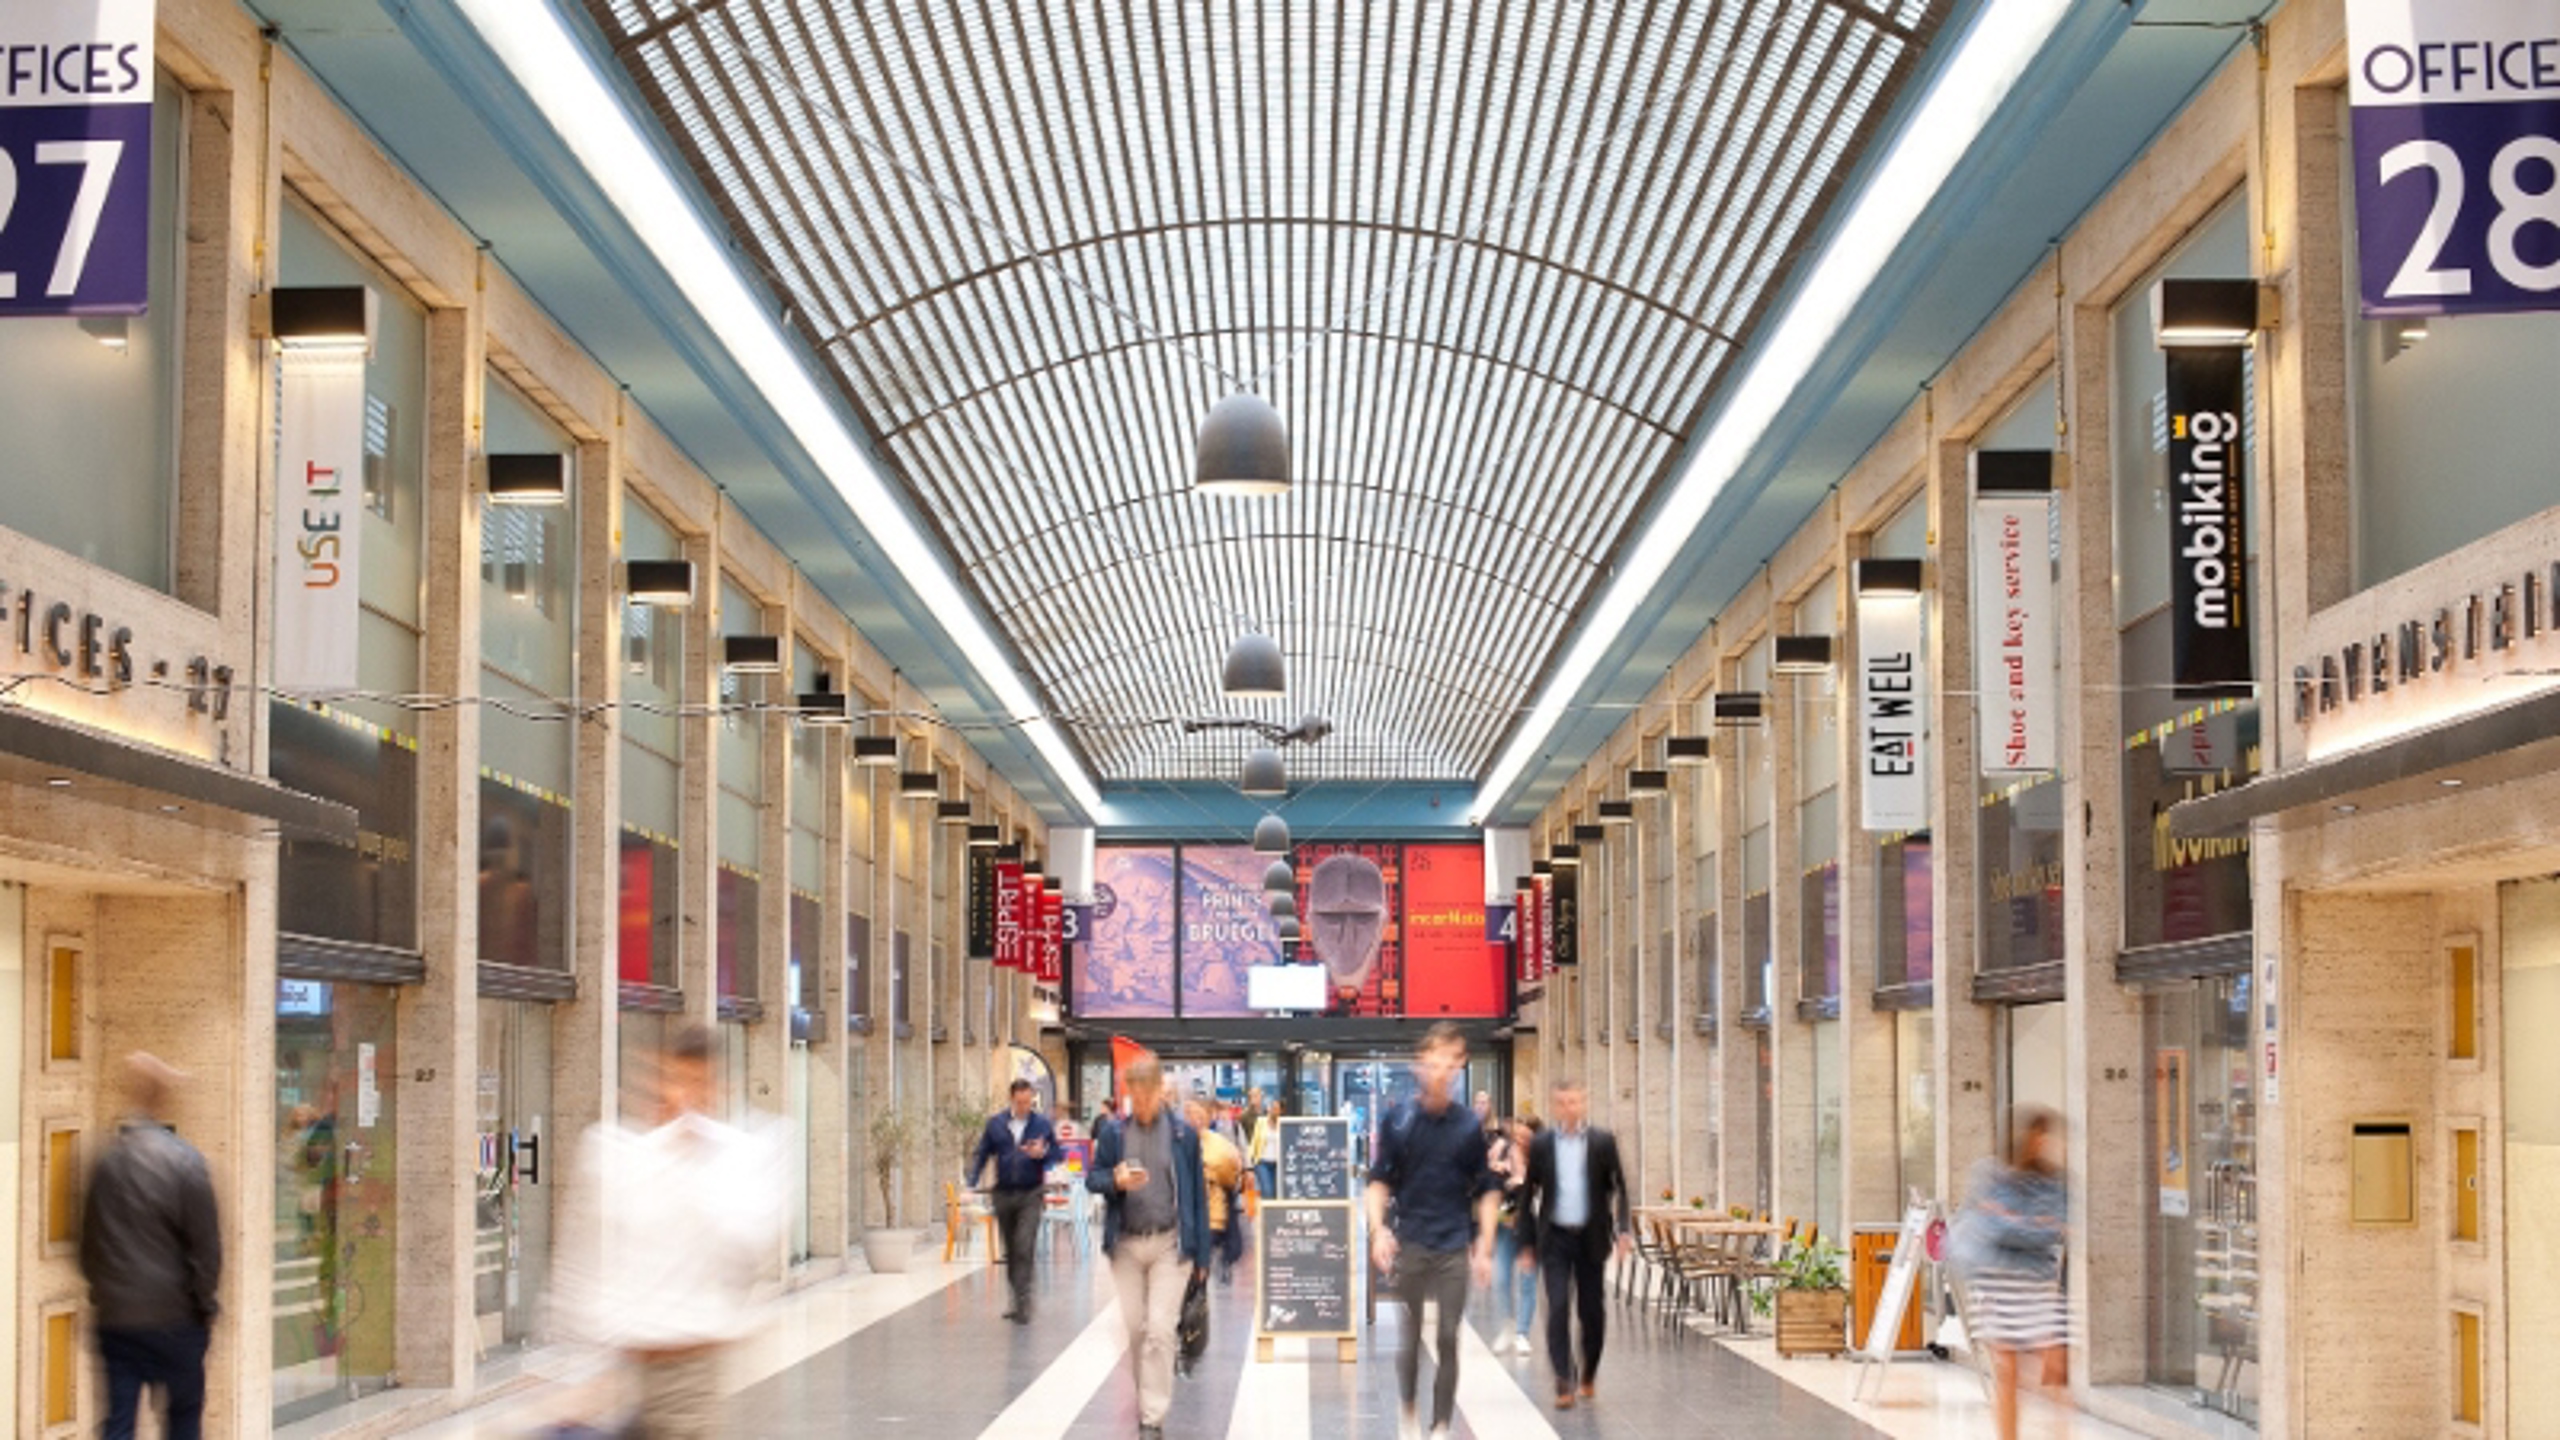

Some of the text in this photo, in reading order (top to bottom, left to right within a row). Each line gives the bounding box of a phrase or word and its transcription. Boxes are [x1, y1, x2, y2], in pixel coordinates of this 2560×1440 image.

[0, 44, 139, 95] FICES
[0, 139, 125, 299] 7
[2378, 135, 2560, 298] 28
[296, 460, 341, 589] USE IT
[2179, 411, 2239, 628] mobiking
[0, 582, 132, 684] ICES
[2000, 514, 2029, 768] Shoe and key service
[1868, 652, 1912, 717] WELL
[1871, 727, 1914, 775] EAT
[995, 869, 1019, 960] ESPRIT
[1062, 907, 1078, 939] 3
[1499, 910, 1517, 941] 4
